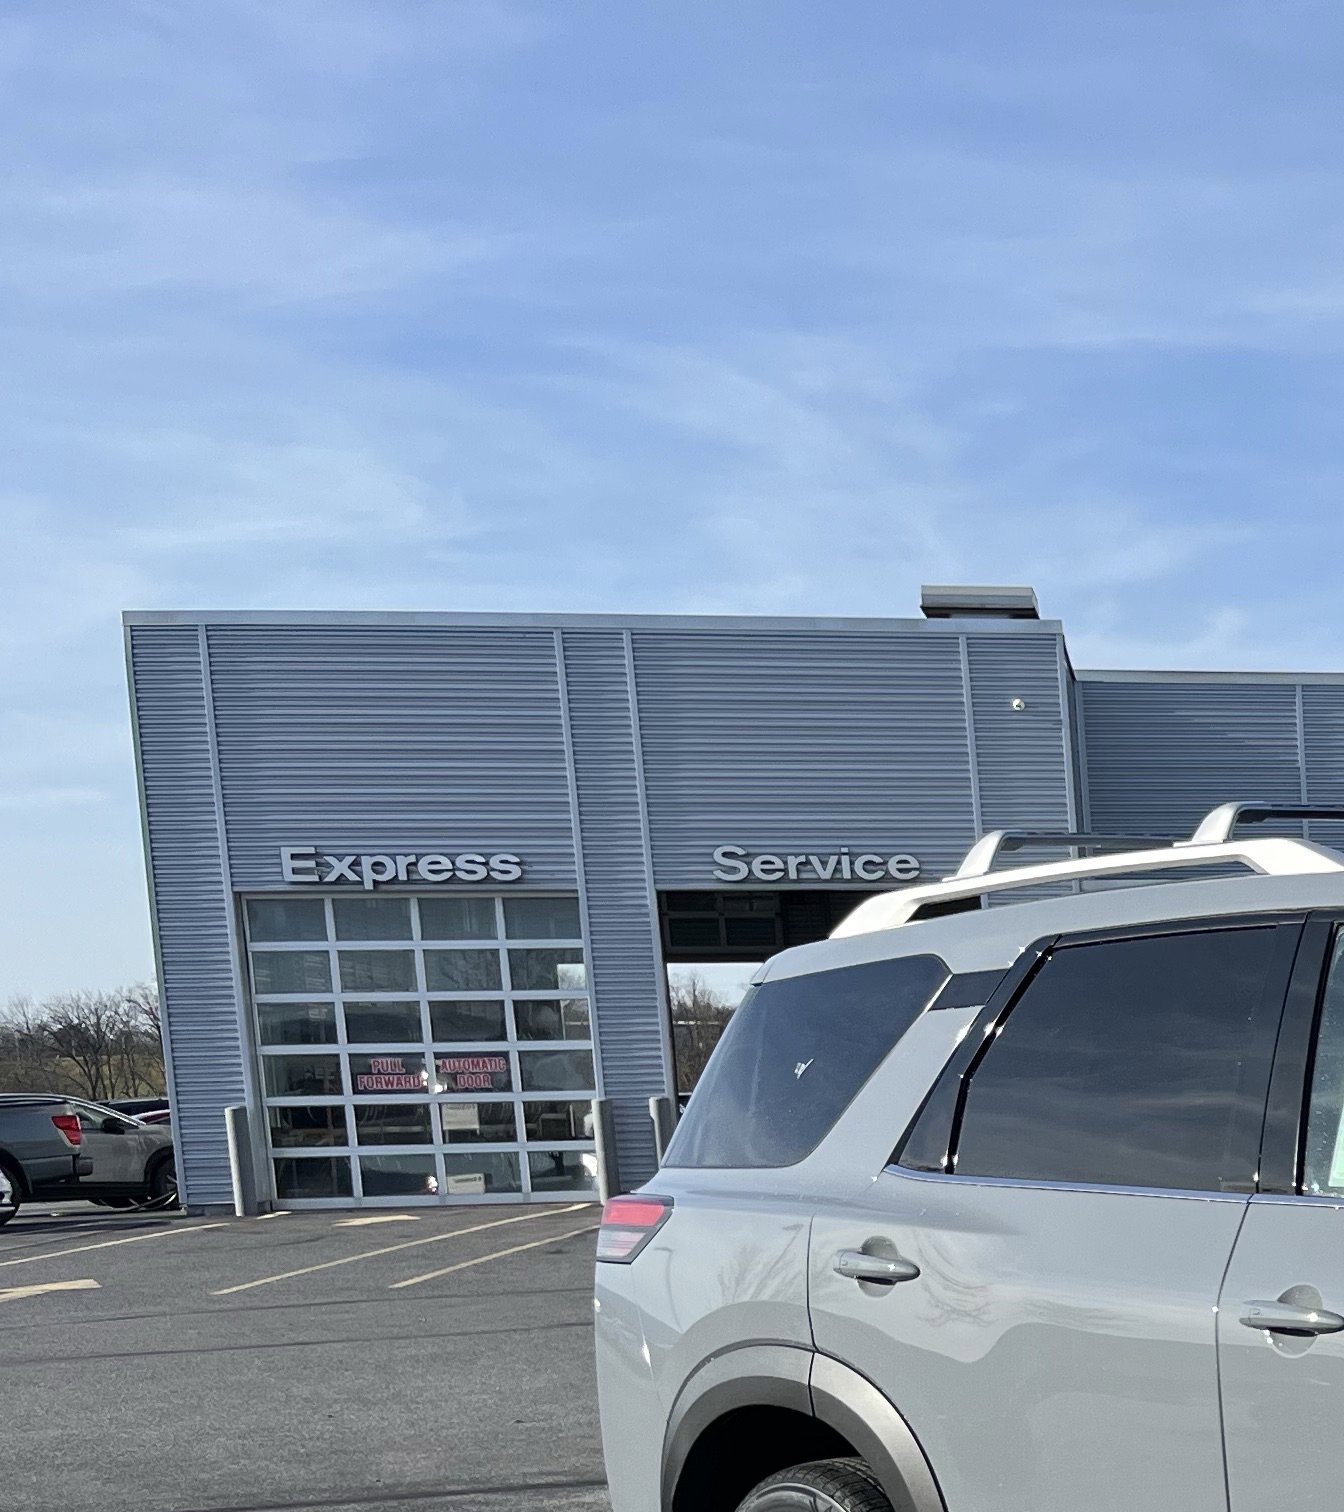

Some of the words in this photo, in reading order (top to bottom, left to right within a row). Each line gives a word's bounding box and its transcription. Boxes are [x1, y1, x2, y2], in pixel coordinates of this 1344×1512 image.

[280, 847, 522, 889] Express
[712, 845, 920, 881] Service
[371, 1058, 405, 1073] PULL
[439, 1057, 506, 1072] AUTOMATIC
[357, 1075, 424, 1090] FORWARD
[456, 1074, 492, 1088] DOOR
